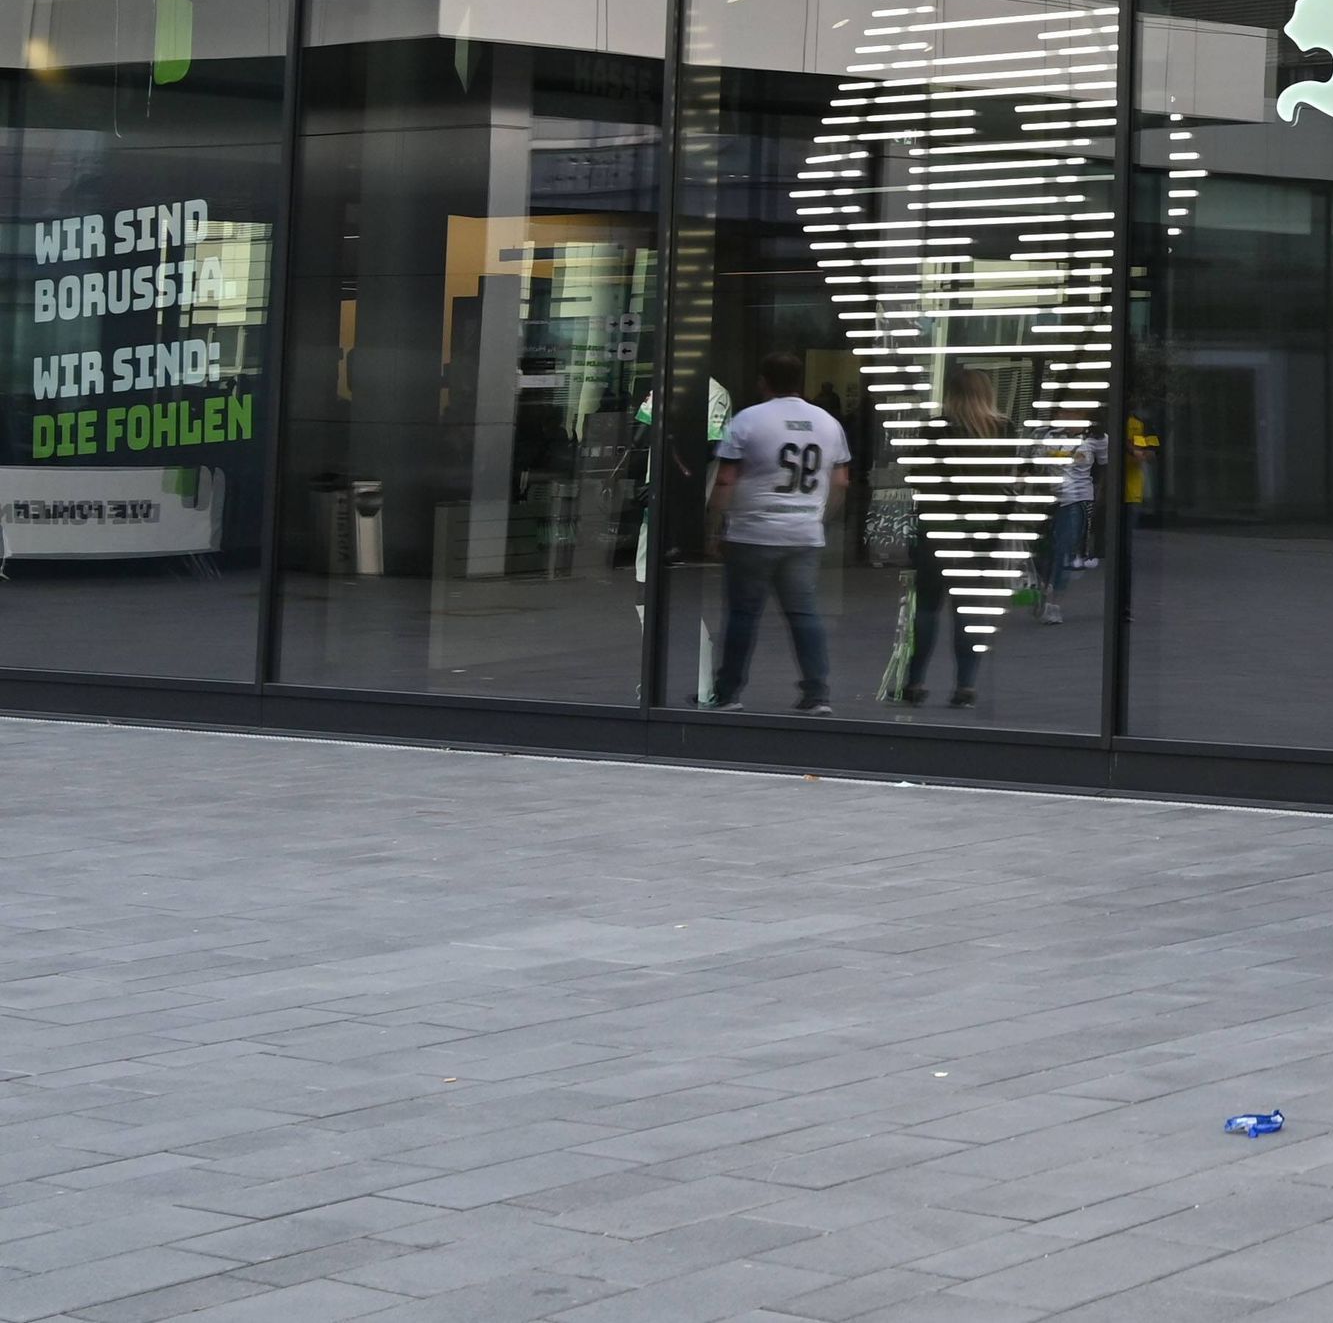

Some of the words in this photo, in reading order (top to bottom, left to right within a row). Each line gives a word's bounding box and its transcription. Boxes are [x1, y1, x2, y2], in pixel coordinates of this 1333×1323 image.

[35, 213, 106, 265] WIR
[114, 198, 209, 255] SIND
[33, 350, 104, 400] WIR
[112, 338, 220, 393] SIND:
[32, 409, 98, 458] DIE
[106, 393, 252, 452] FOHLEN
